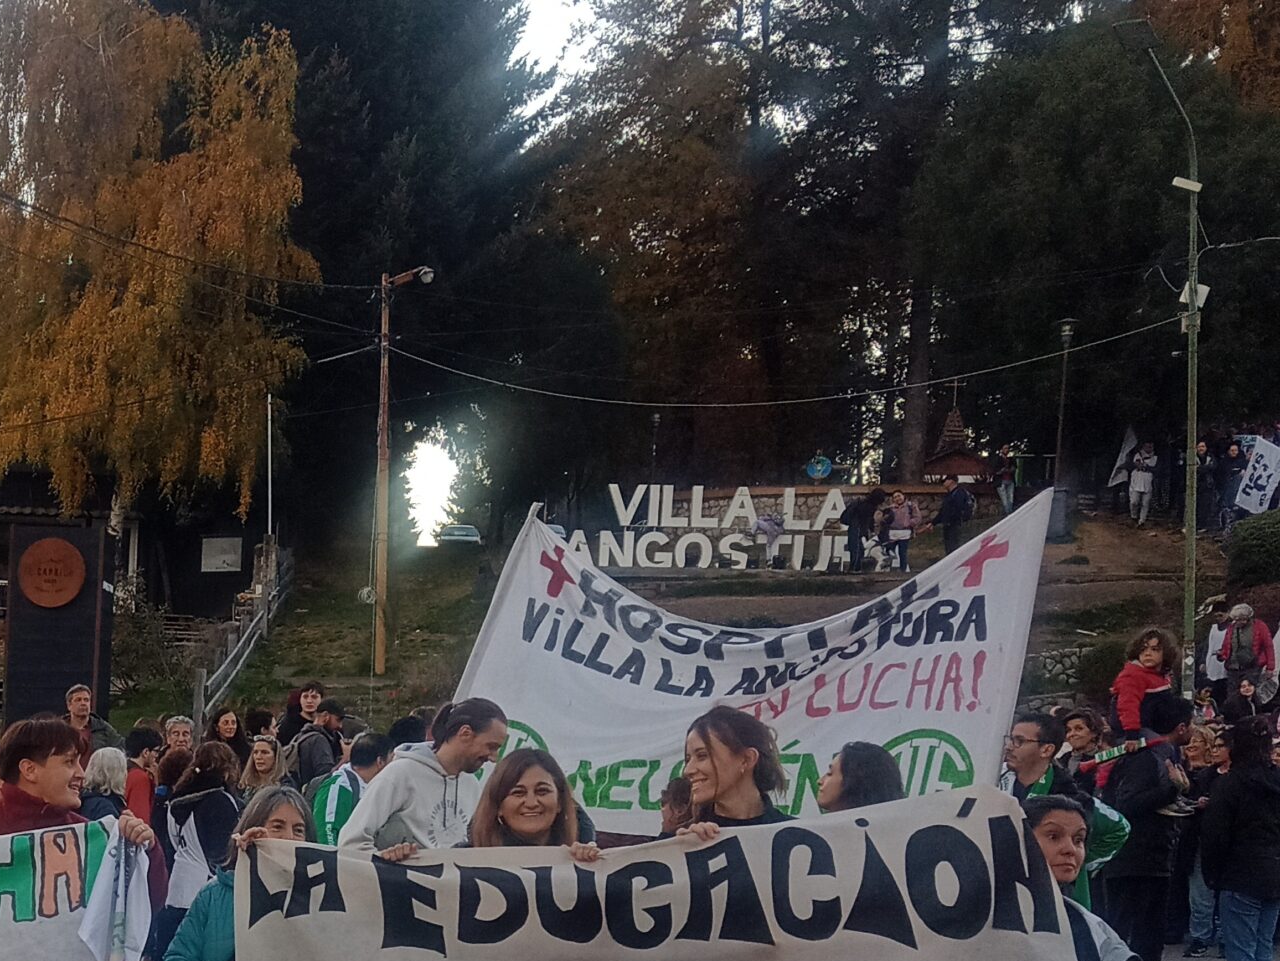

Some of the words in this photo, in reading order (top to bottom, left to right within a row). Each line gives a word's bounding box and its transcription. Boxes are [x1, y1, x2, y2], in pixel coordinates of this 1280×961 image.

[608, 483, 760, 529] VILLA
[783, 486, 850, 531] LA
[654, 657, 715, 698] LA
[804, 649, 987, 719] LUCHA!
[247, 842, 346, 929] LA
